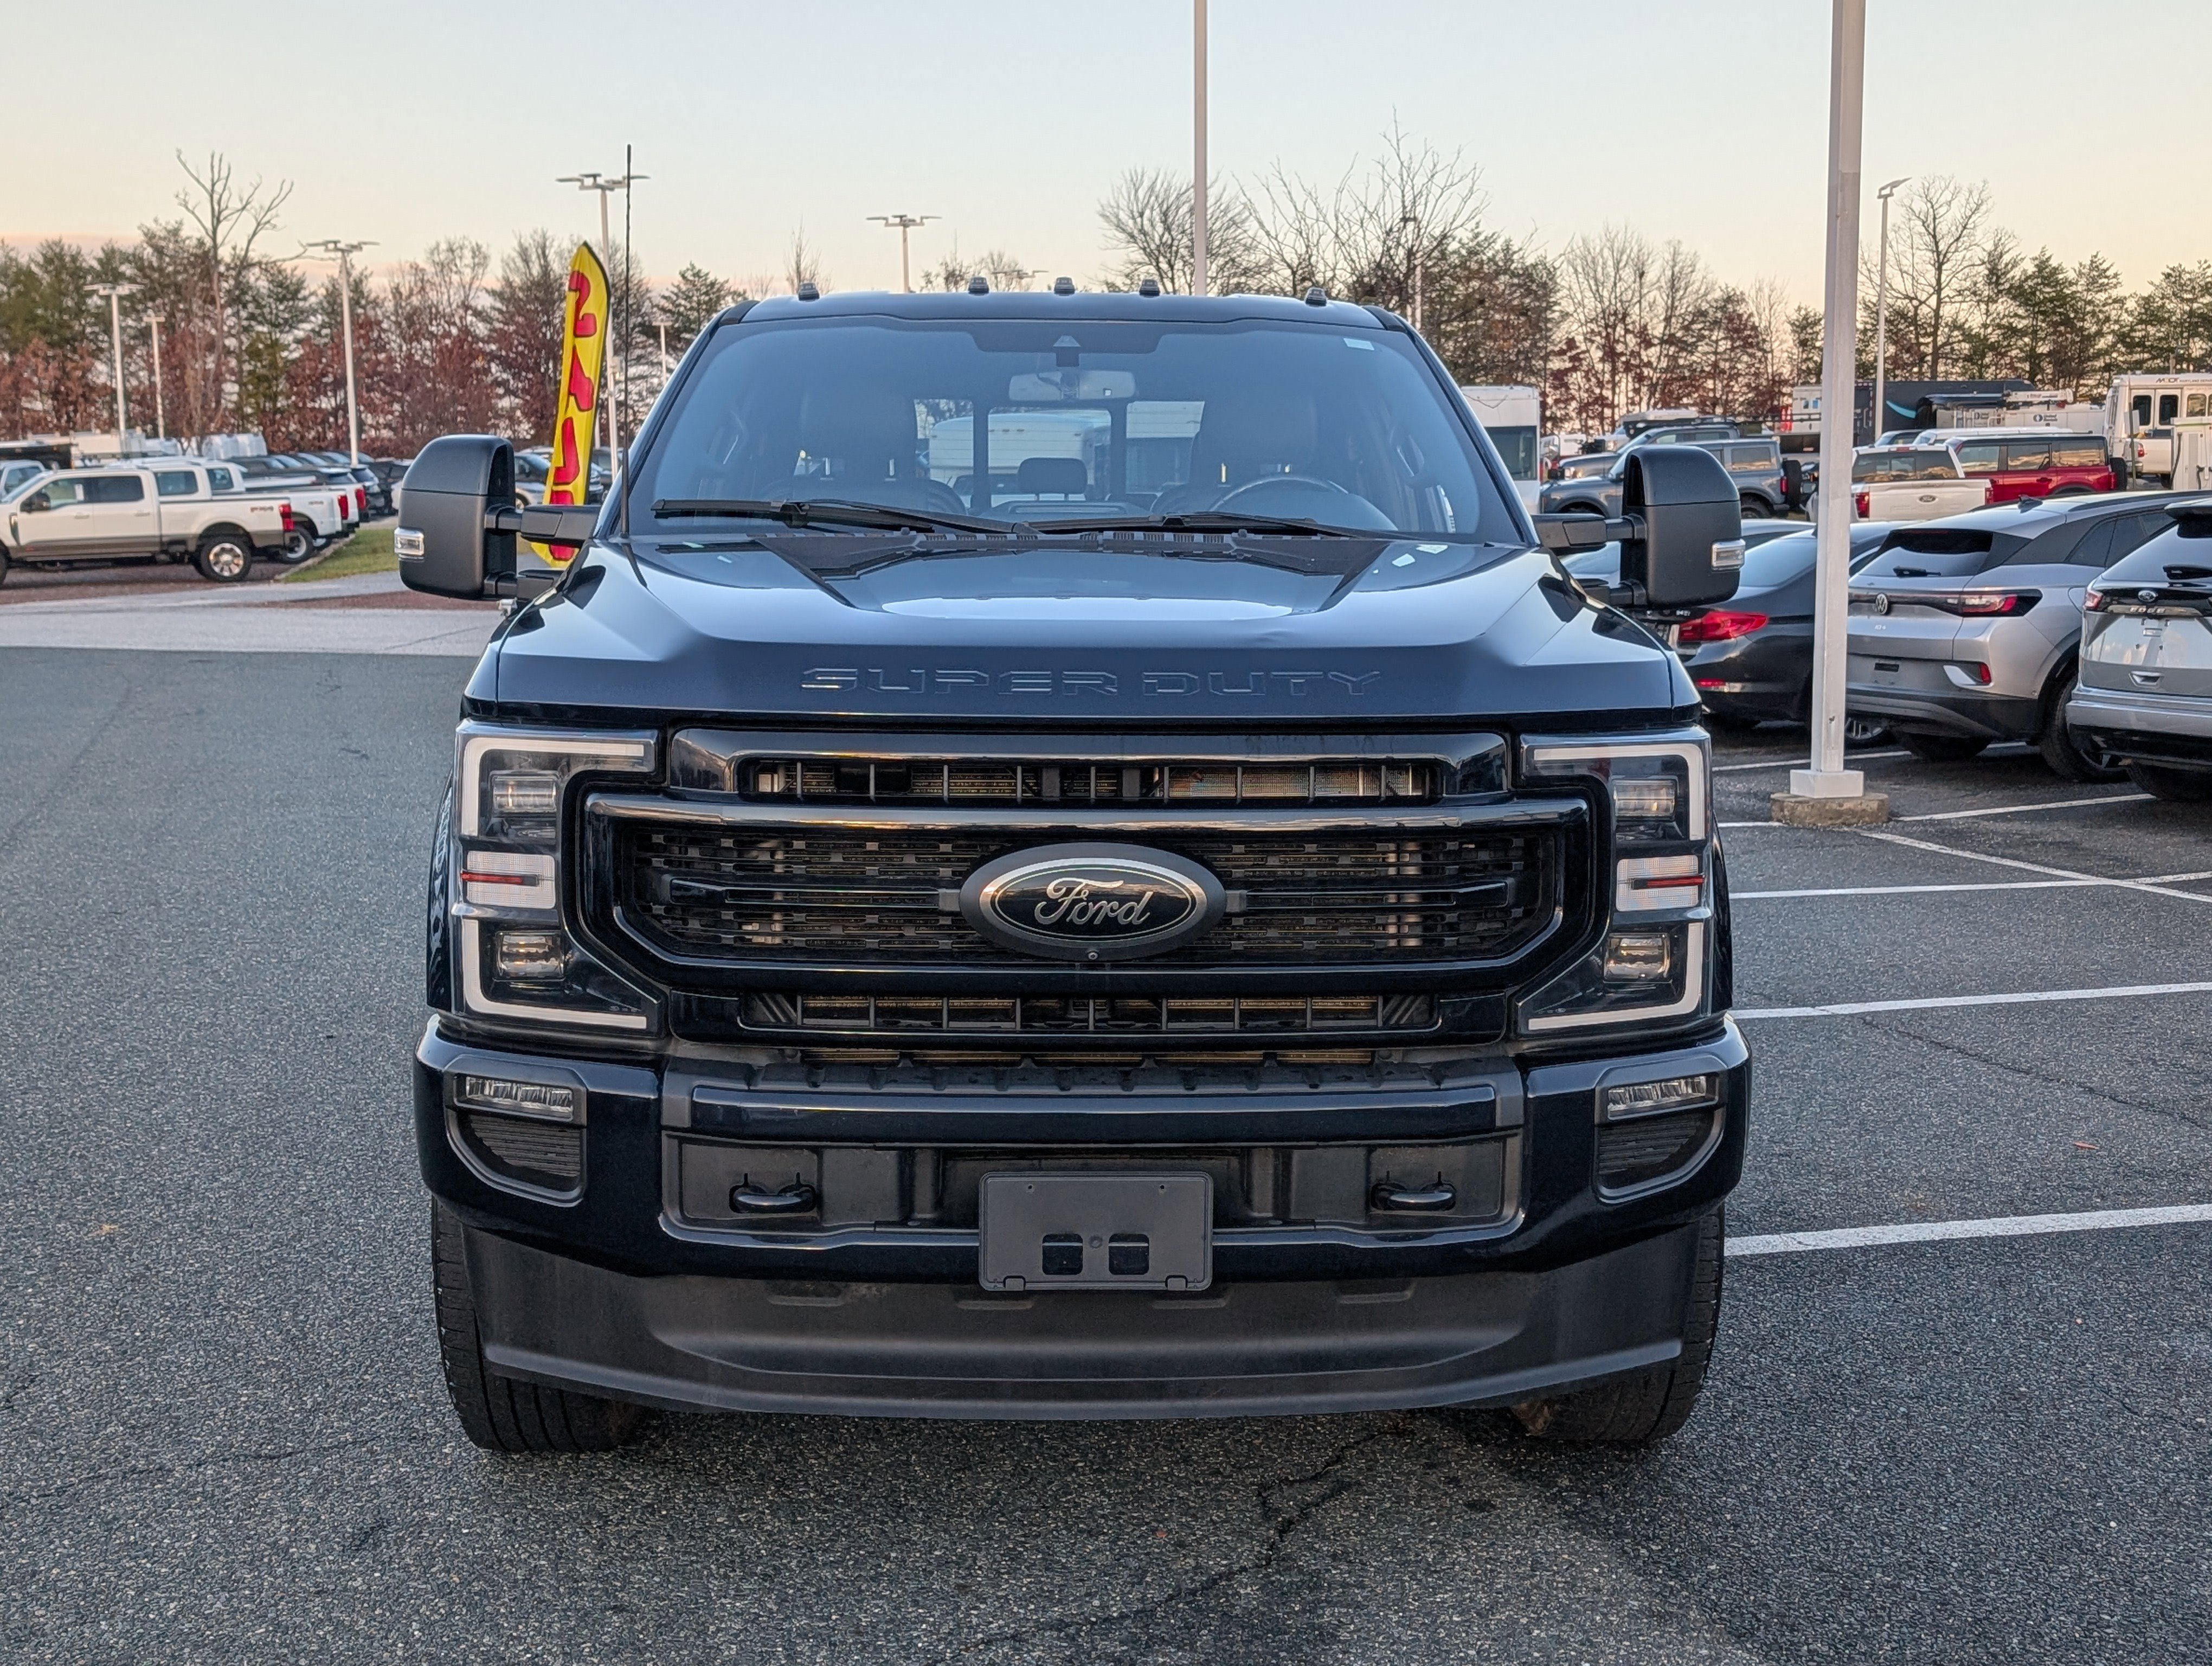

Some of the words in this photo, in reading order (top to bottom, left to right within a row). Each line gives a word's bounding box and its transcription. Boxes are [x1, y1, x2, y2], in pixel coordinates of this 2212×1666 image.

[800, 667, 1118, 696] SUPER
[1141, 670, 1381, 696] DUTY
[1034, 876, 1154, 927] Ford
